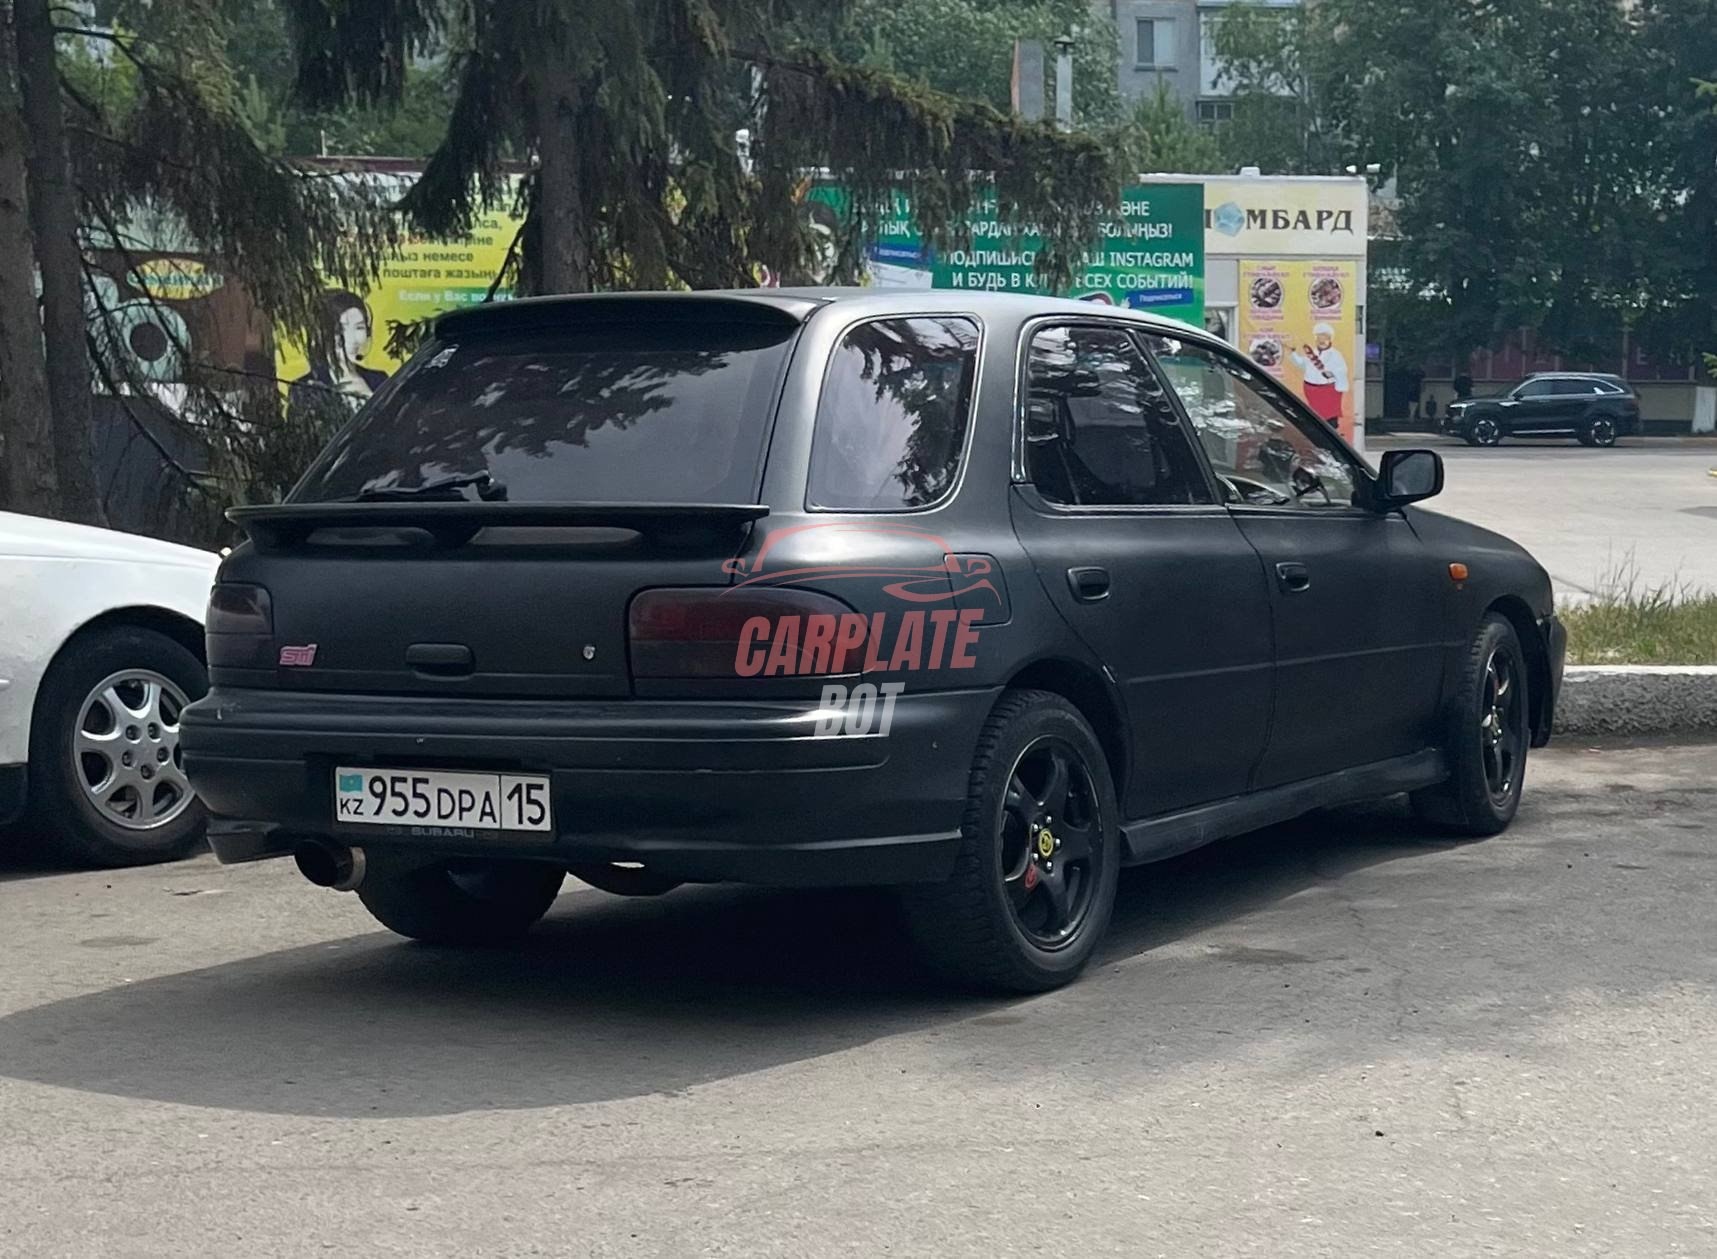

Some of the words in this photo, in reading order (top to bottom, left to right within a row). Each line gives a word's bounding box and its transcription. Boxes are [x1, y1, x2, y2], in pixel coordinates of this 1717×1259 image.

[1108, 200, 1150, 216] ӘНЕ
[1110, 251, 1194, 268] INSTAGRAM
[952, 272, 963, 287] И
[968, 272, 1007, 292] БУДЬ
[1011, 272, 1020, 287] В
[1117, 271, 1193, 289] СОБЫТИЙ!
[340, 798, 364, 816] KZ
[506, 783, 546, 826] 15
[411, 826, 475, 839] SUBARU
